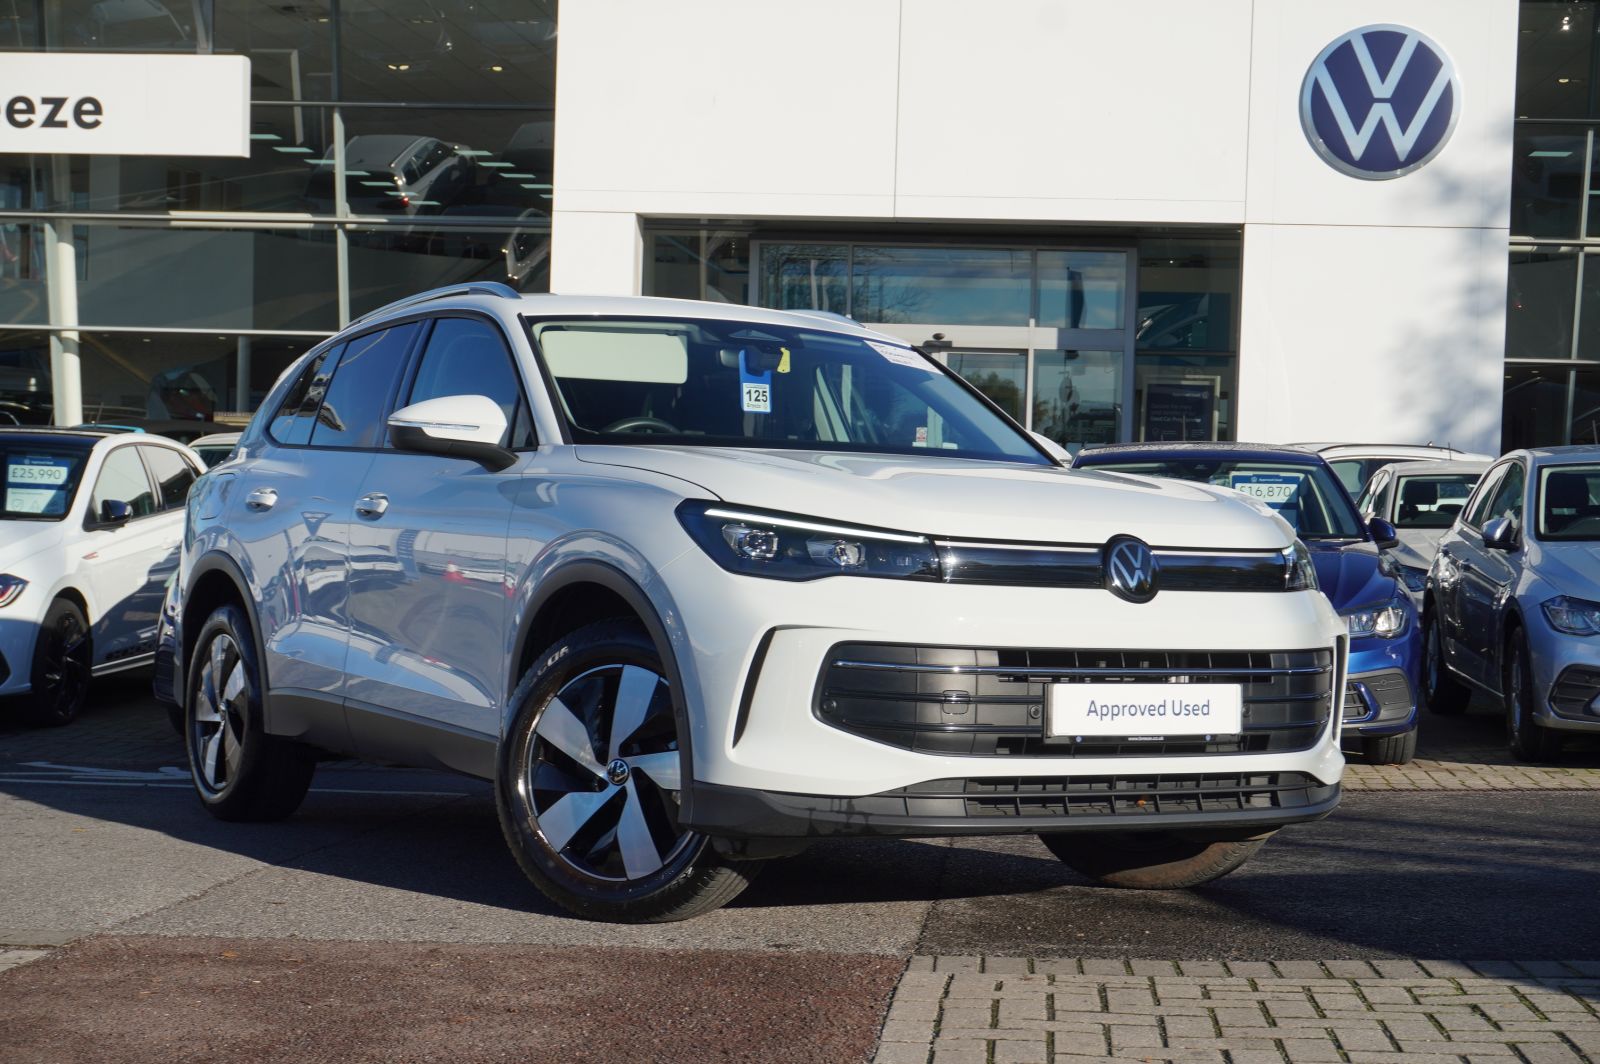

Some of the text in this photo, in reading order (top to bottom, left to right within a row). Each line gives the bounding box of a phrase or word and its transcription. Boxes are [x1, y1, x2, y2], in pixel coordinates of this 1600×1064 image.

[1305, 27, 1457, 174] VW
[0, 95, 103, 130] eze
[746, 389, 768, 403] 125
[11, 467, 61, 480] £25,990
[1086, 699, 1210, 721] Approved Used
